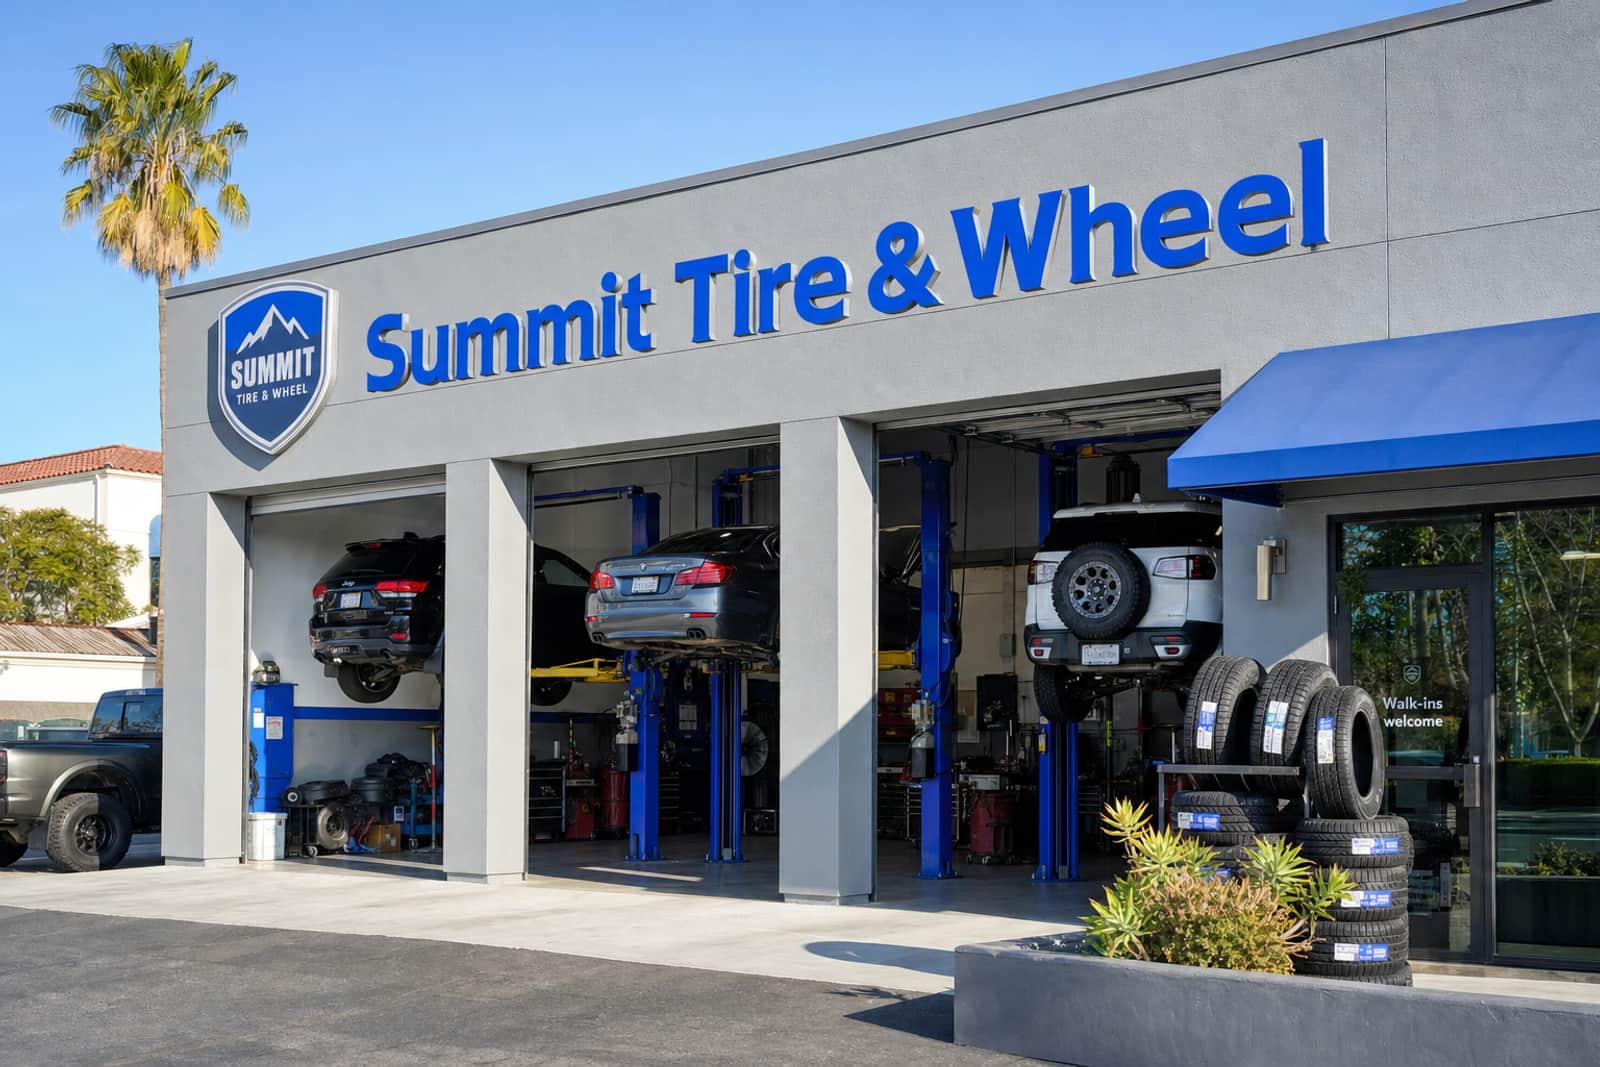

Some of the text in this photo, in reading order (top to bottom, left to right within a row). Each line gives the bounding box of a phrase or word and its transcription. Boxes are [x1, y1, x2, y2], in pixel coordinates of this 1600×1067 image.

[366, 138, 1328, 392] Summit Tire & Wheel
[231, 346, 315, 389] SUMMIT
[237, 384, 308, 405] TIRE & WHEEL
[1382, 696, 1443, 710] Walk-ins
[1383, 714, 1443, 727] welcome
